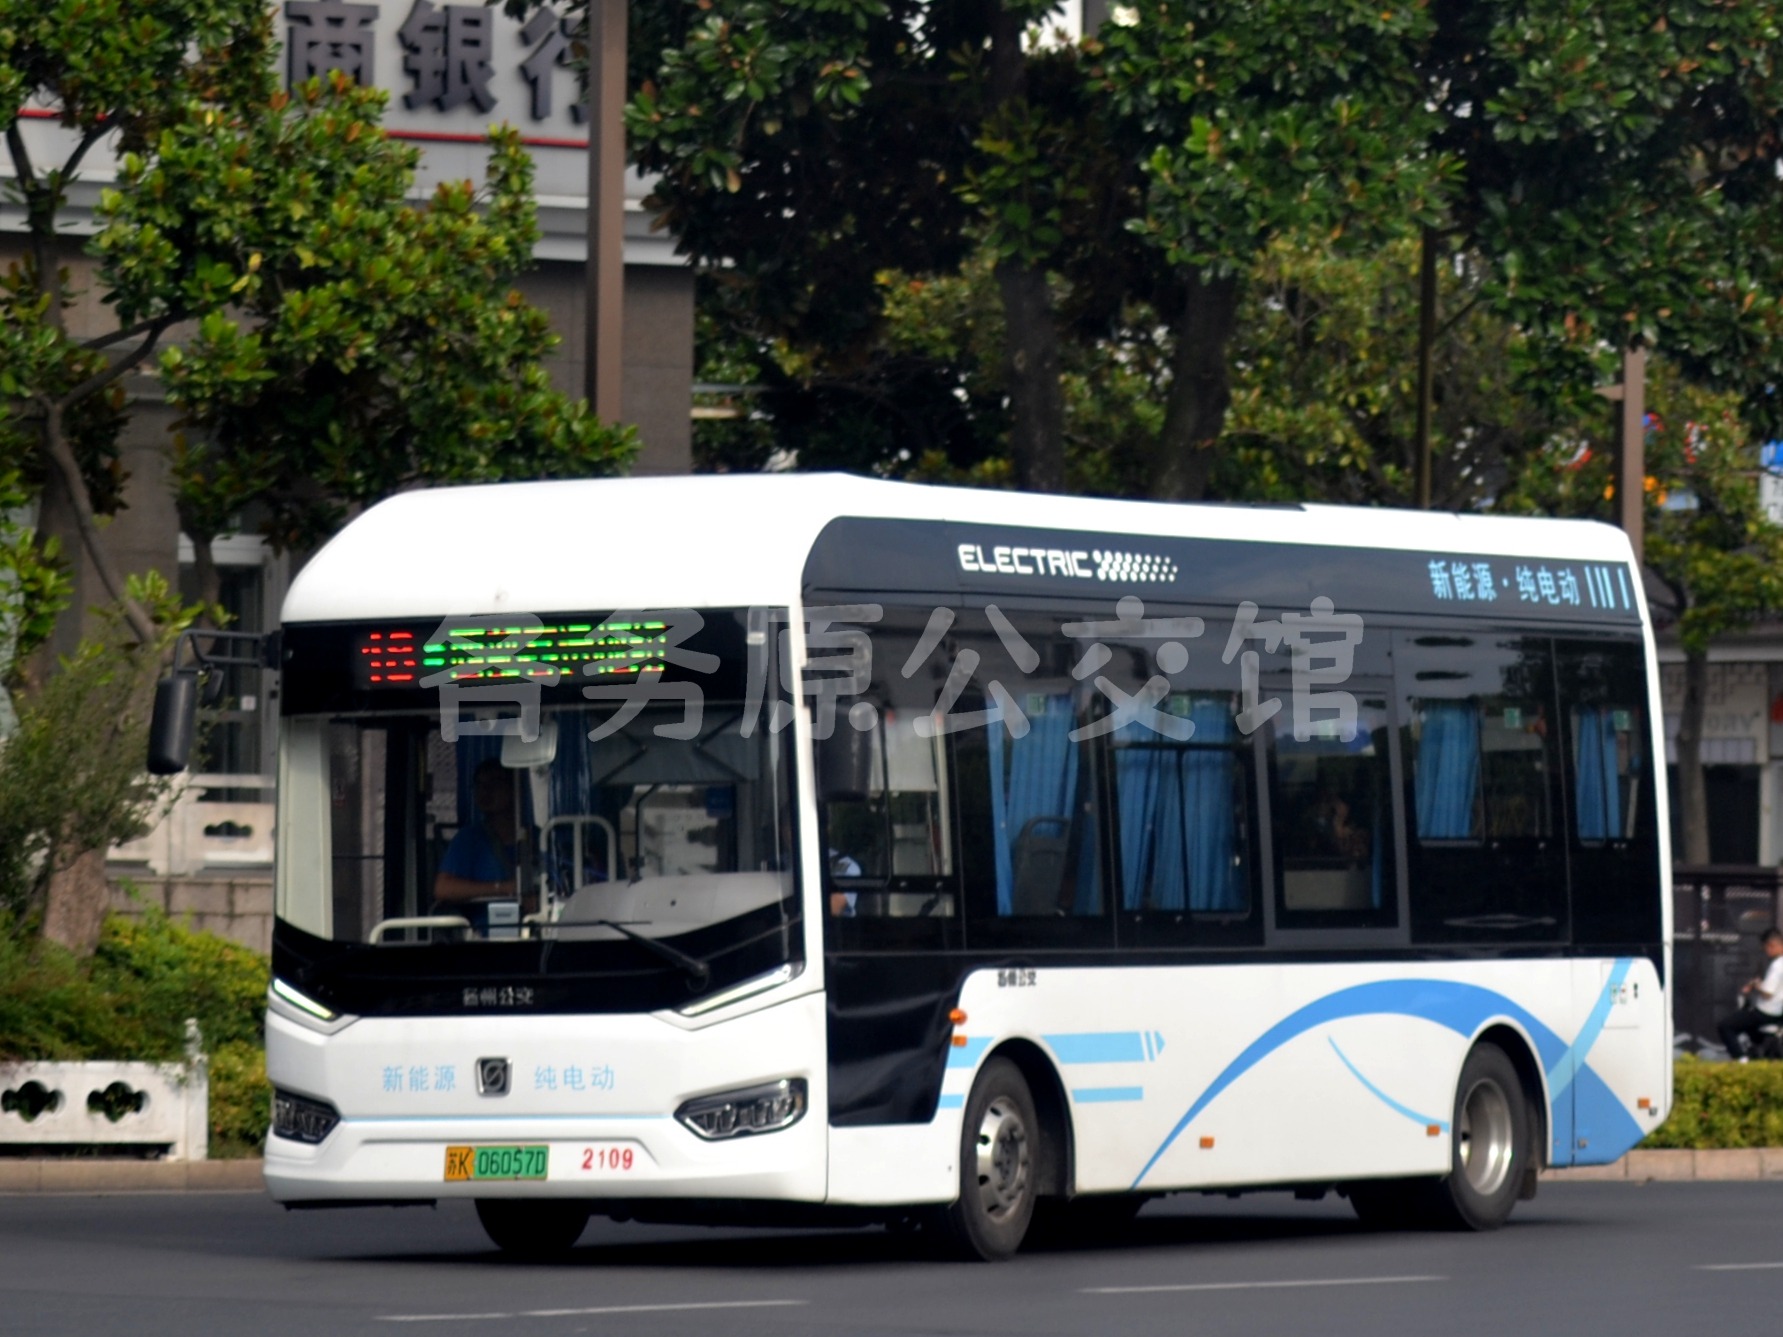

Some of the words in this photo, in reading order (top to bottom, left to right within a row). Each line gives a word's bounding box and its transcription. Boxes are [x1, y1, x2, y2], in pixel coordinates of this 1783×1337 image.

[958, 544, 1093, 578] ELECTRIC
[382, 1064, 456, 1093] 新能源
[534, 1064, 615, 1092] 纯电动
[581, 1147, 634, 1171] 2109
